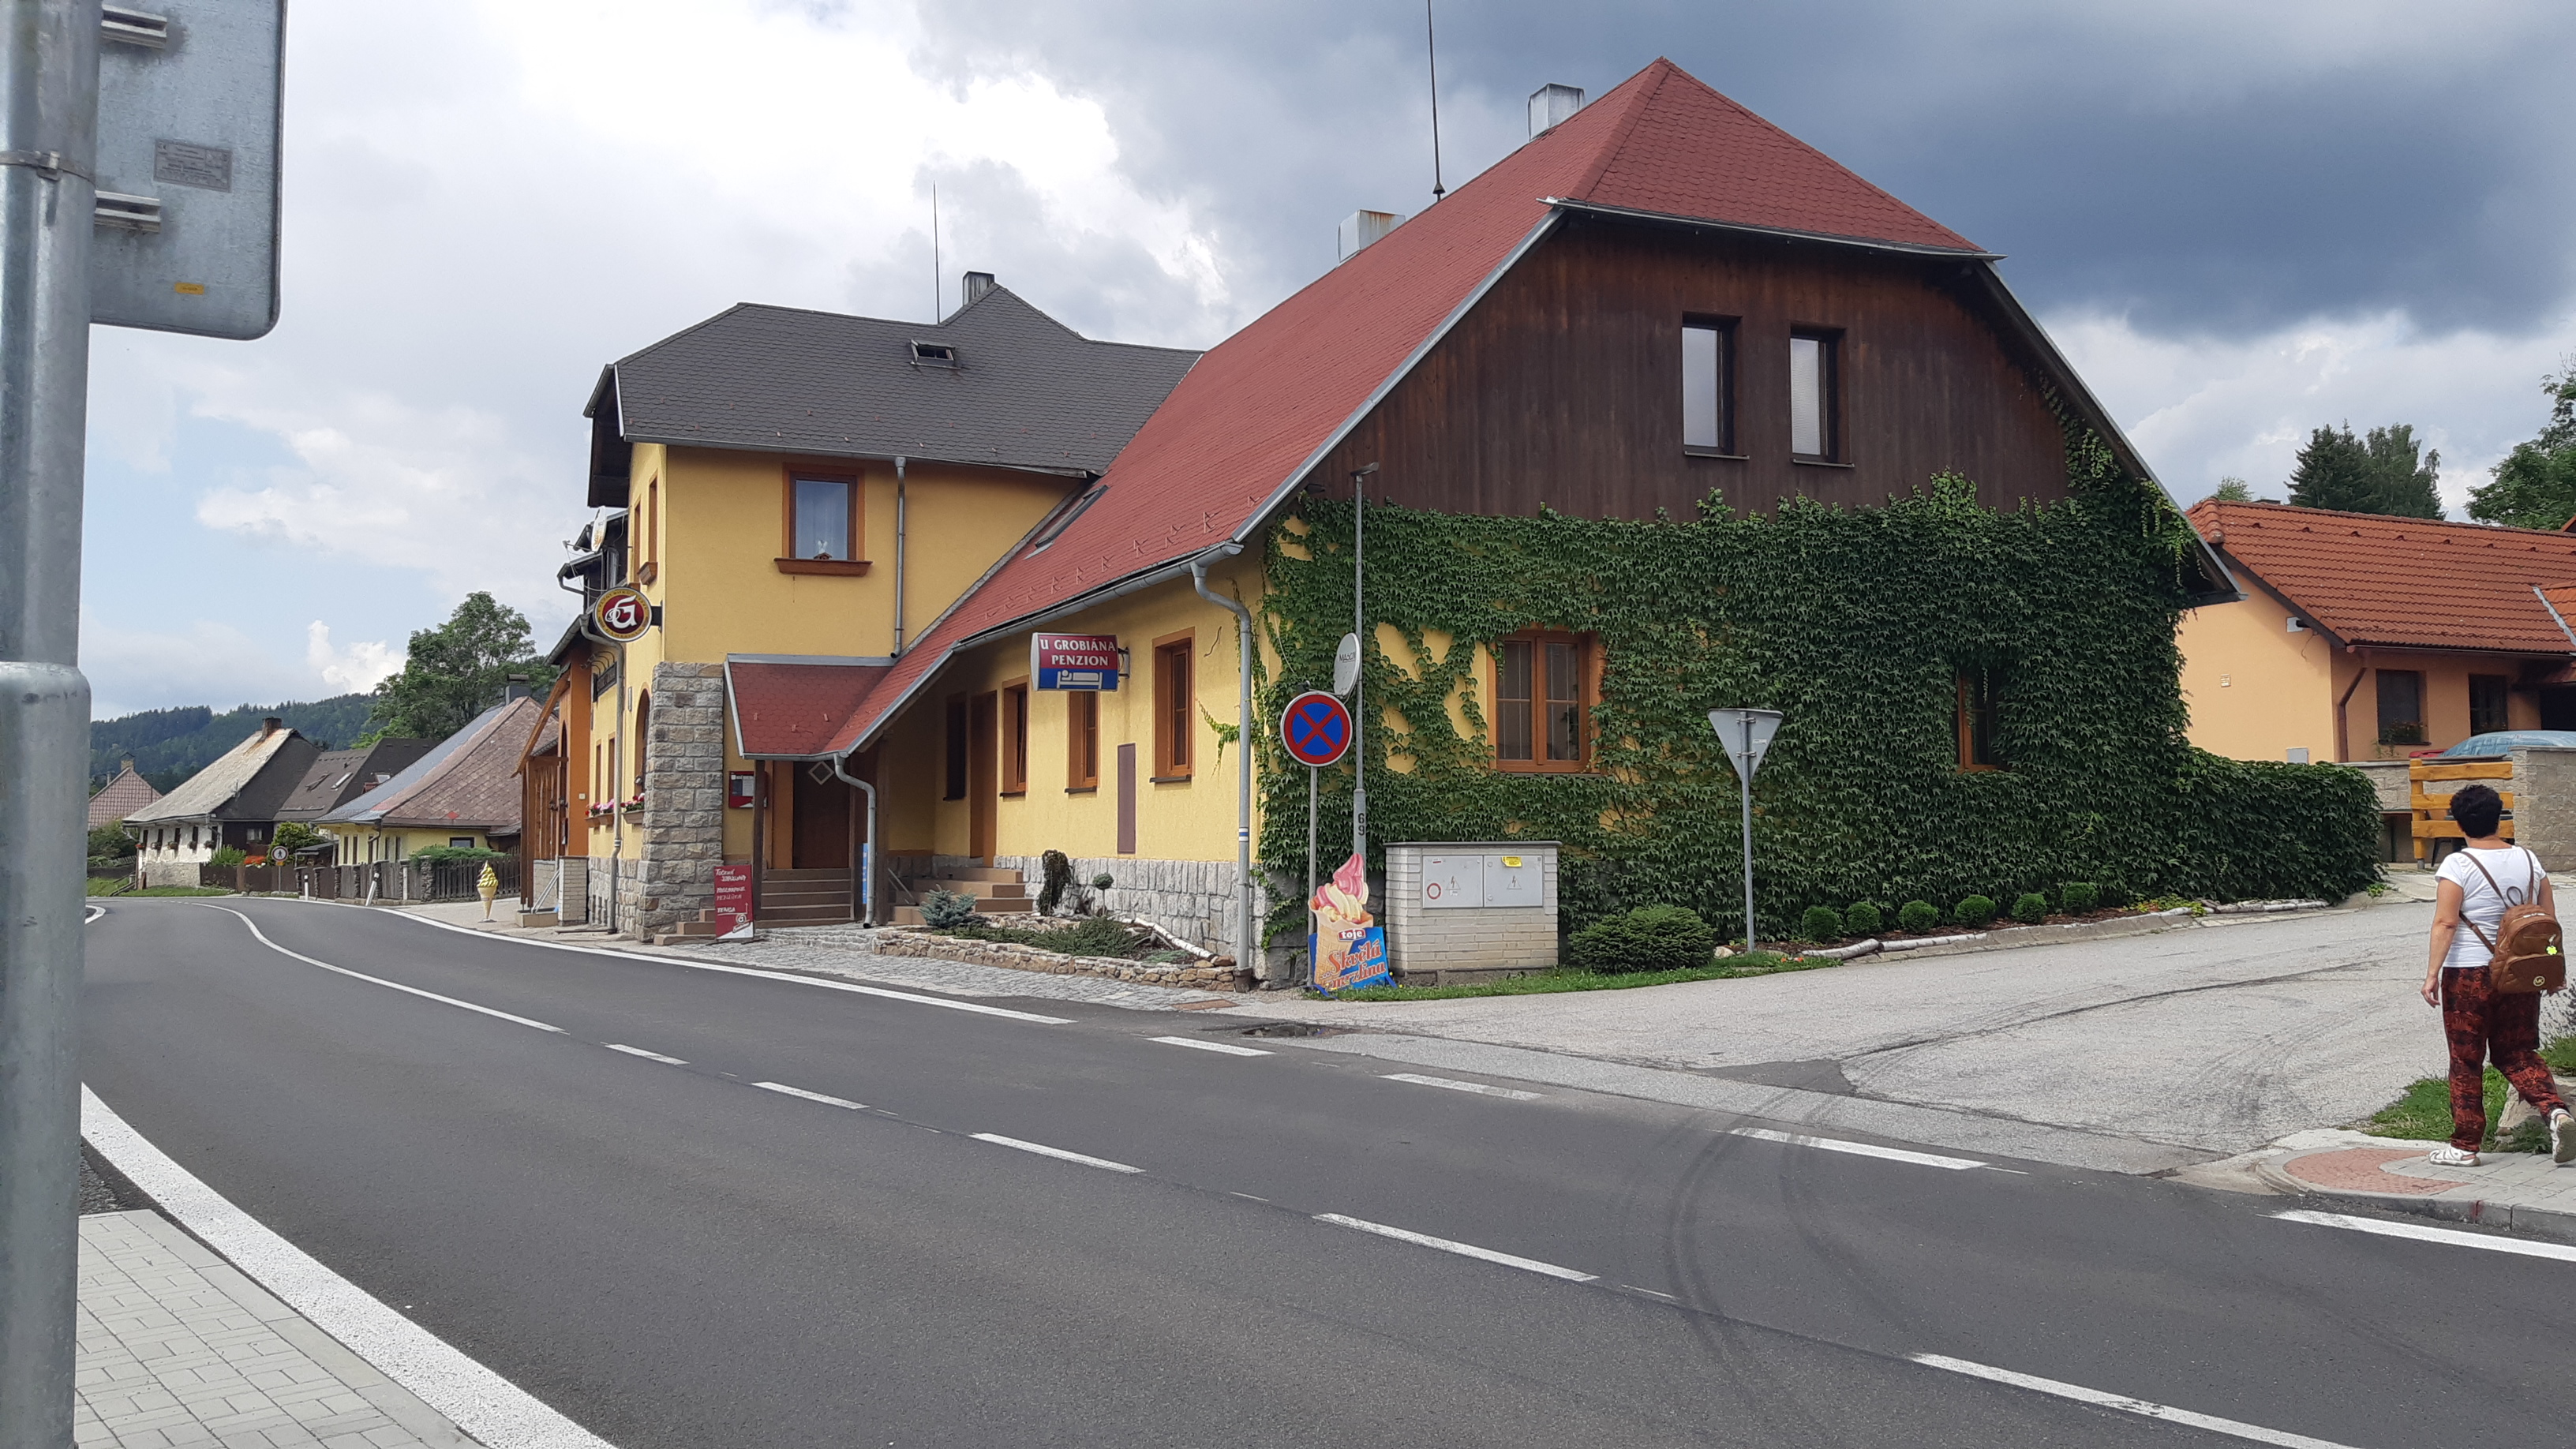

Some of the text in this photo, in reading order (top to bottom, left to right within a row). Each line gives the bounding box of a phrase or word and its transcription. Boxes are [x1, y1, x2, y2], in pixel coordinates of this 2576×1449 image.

[1040, 638, 1116, 652] U GROBIÁNA
[1051, 654, 1109, 666] PENZION
